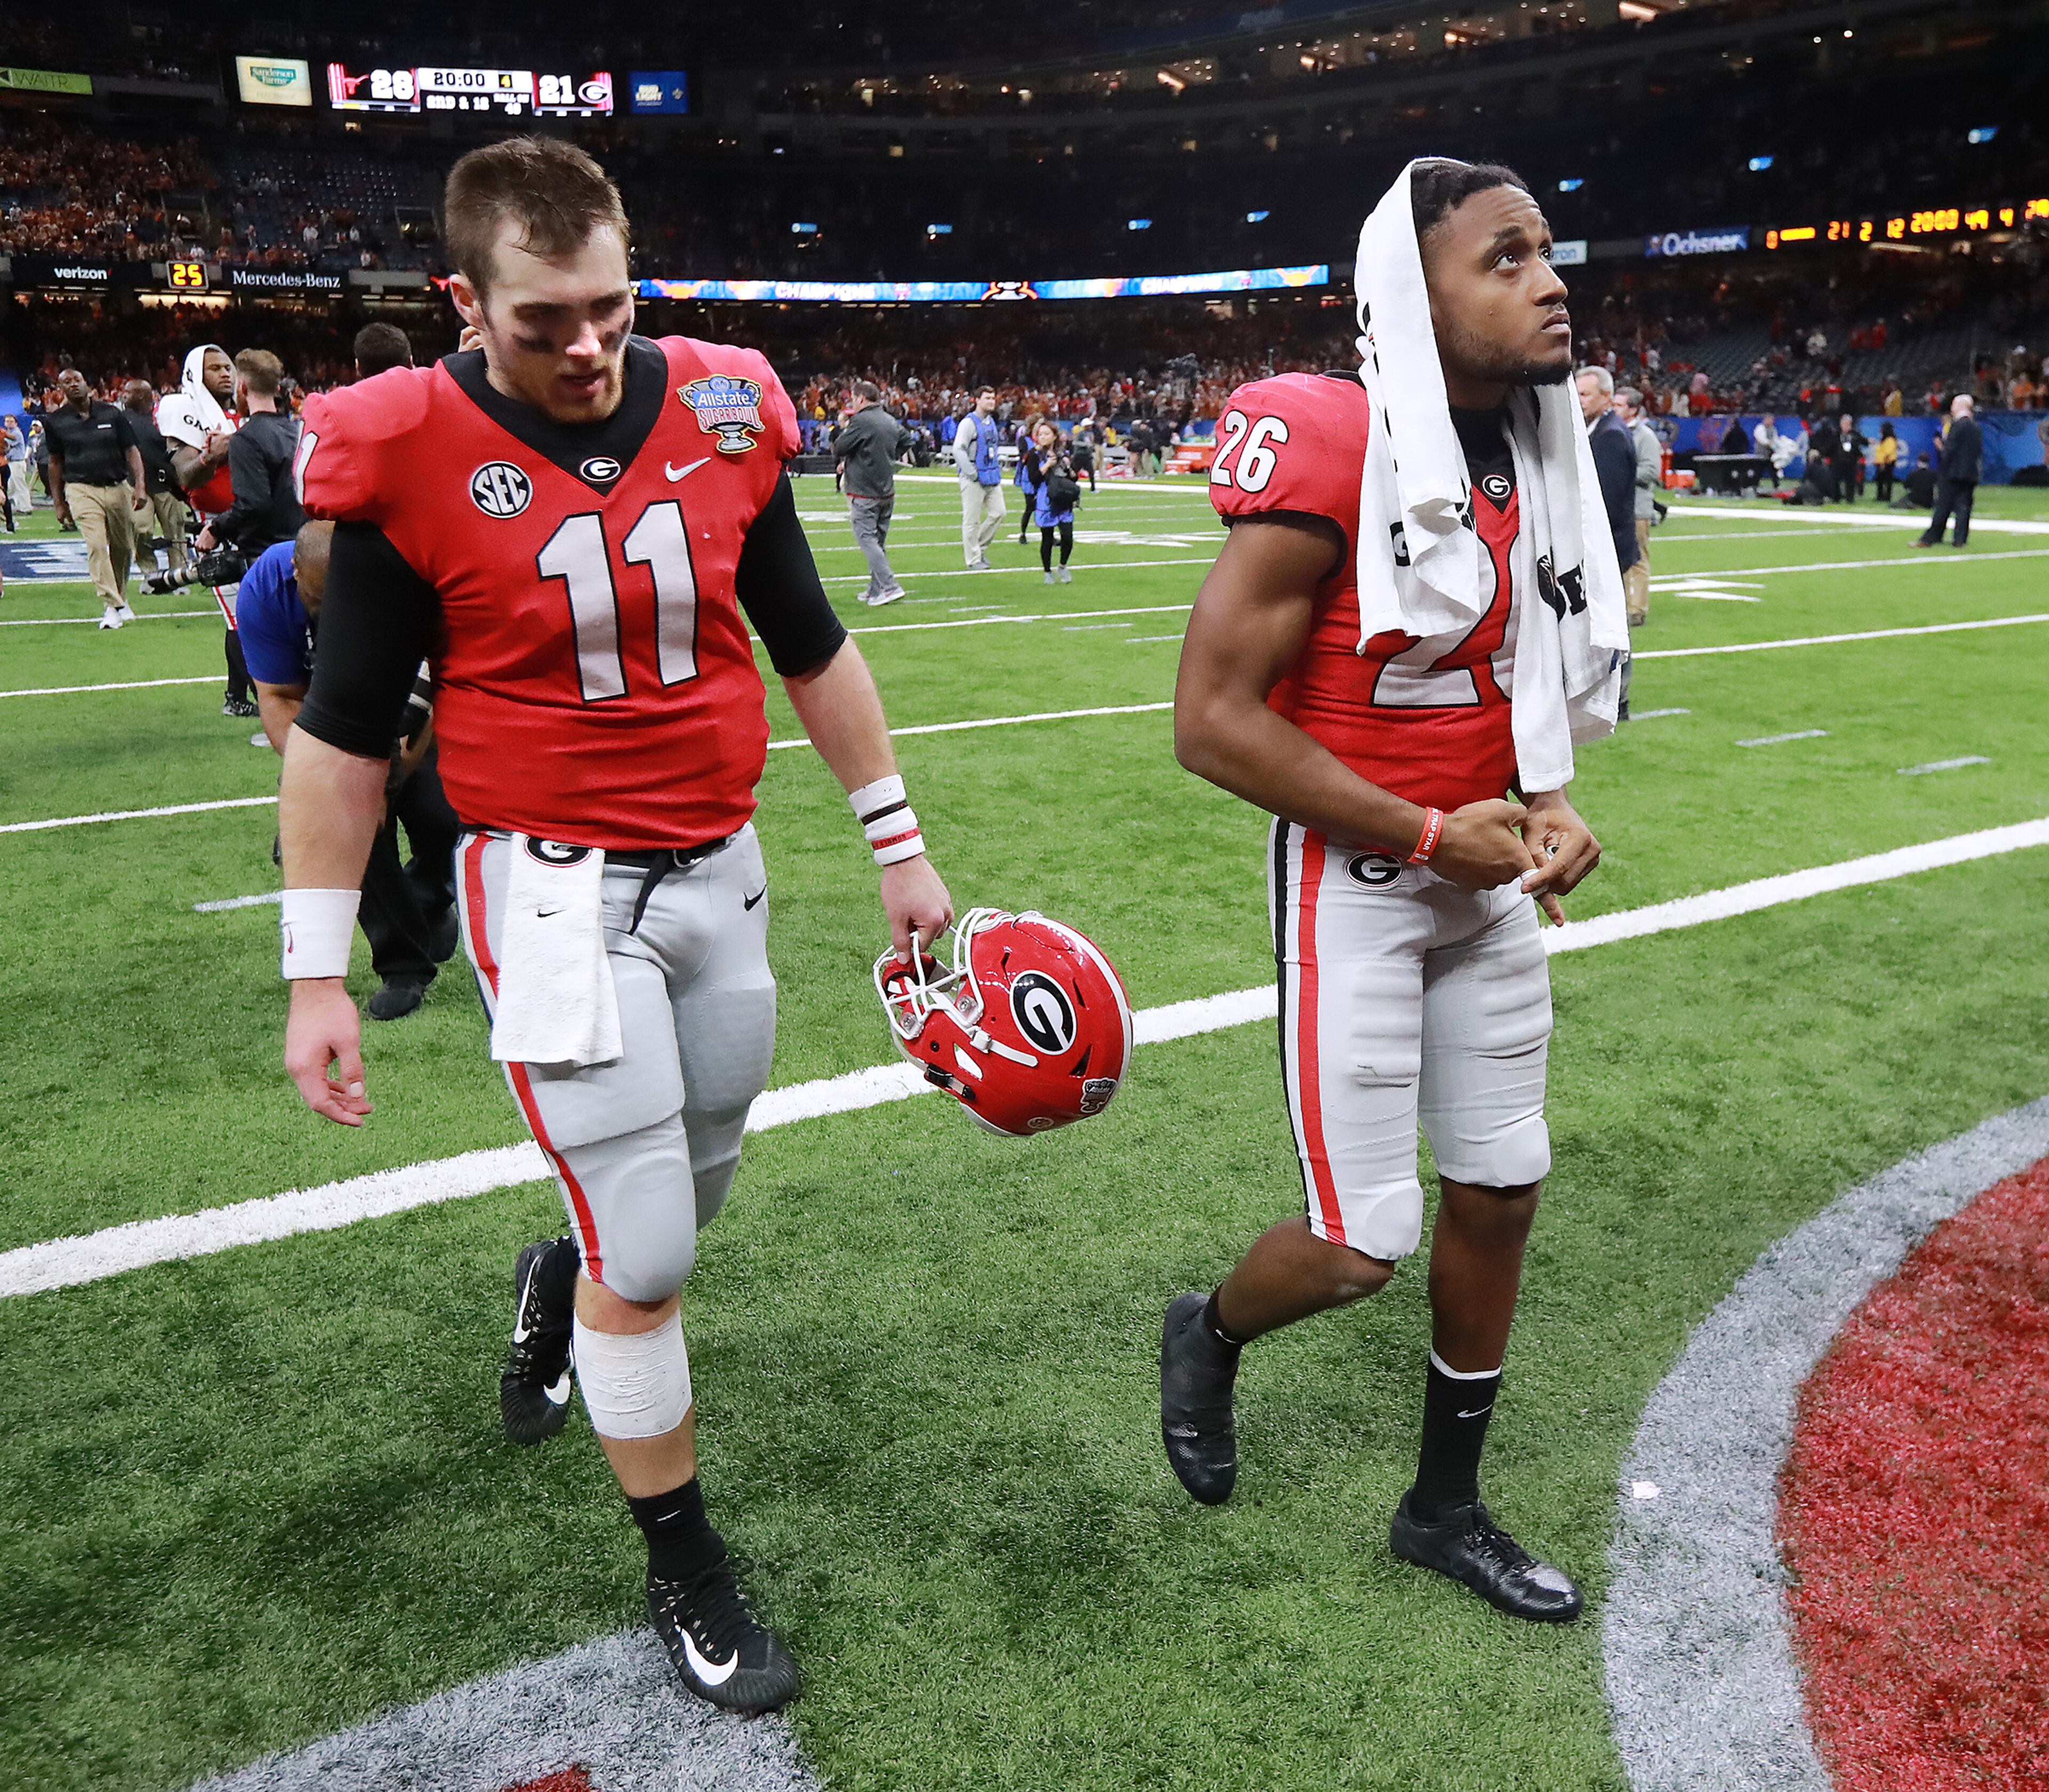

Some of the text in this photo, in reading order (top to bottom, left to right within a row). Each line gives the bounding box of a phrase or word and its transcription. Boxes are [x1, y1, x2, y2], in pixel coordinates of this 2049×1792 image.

[15, 73, 73, 89] WAITR
[251, 67, 294, 77] Sanderson
[262, 76, 287, 86] Farms
[434, 72, 485, 86] 20:00
[371, 69, 415, 100] 28
[538, 75, 575, 104] 21
[1828, 221, 1849, 240] 21
[1860, 222, 1872, 241] 2
[1887, 218, 1905, 238] 12
[2000, 209, 2013, 226] 4
[1662, 231, 1742, 256] Ochsner
[54, 266, 108, 280] verizon
[172, 264, 203, 287] 25
[233, 271, 340, 288] Mercedes-Benz
[775, 282, 875, 300] CHAMPIONS
[697, 392, 750, 407] Allstate
[1210, 409, 1290, 494] 26
[474, 465, 527, 514] SEC
[536, 498, 700, 704] 11
[1430, 814, 1439, 832] TRAP
[1423, 831, 1435, 851] STAR
